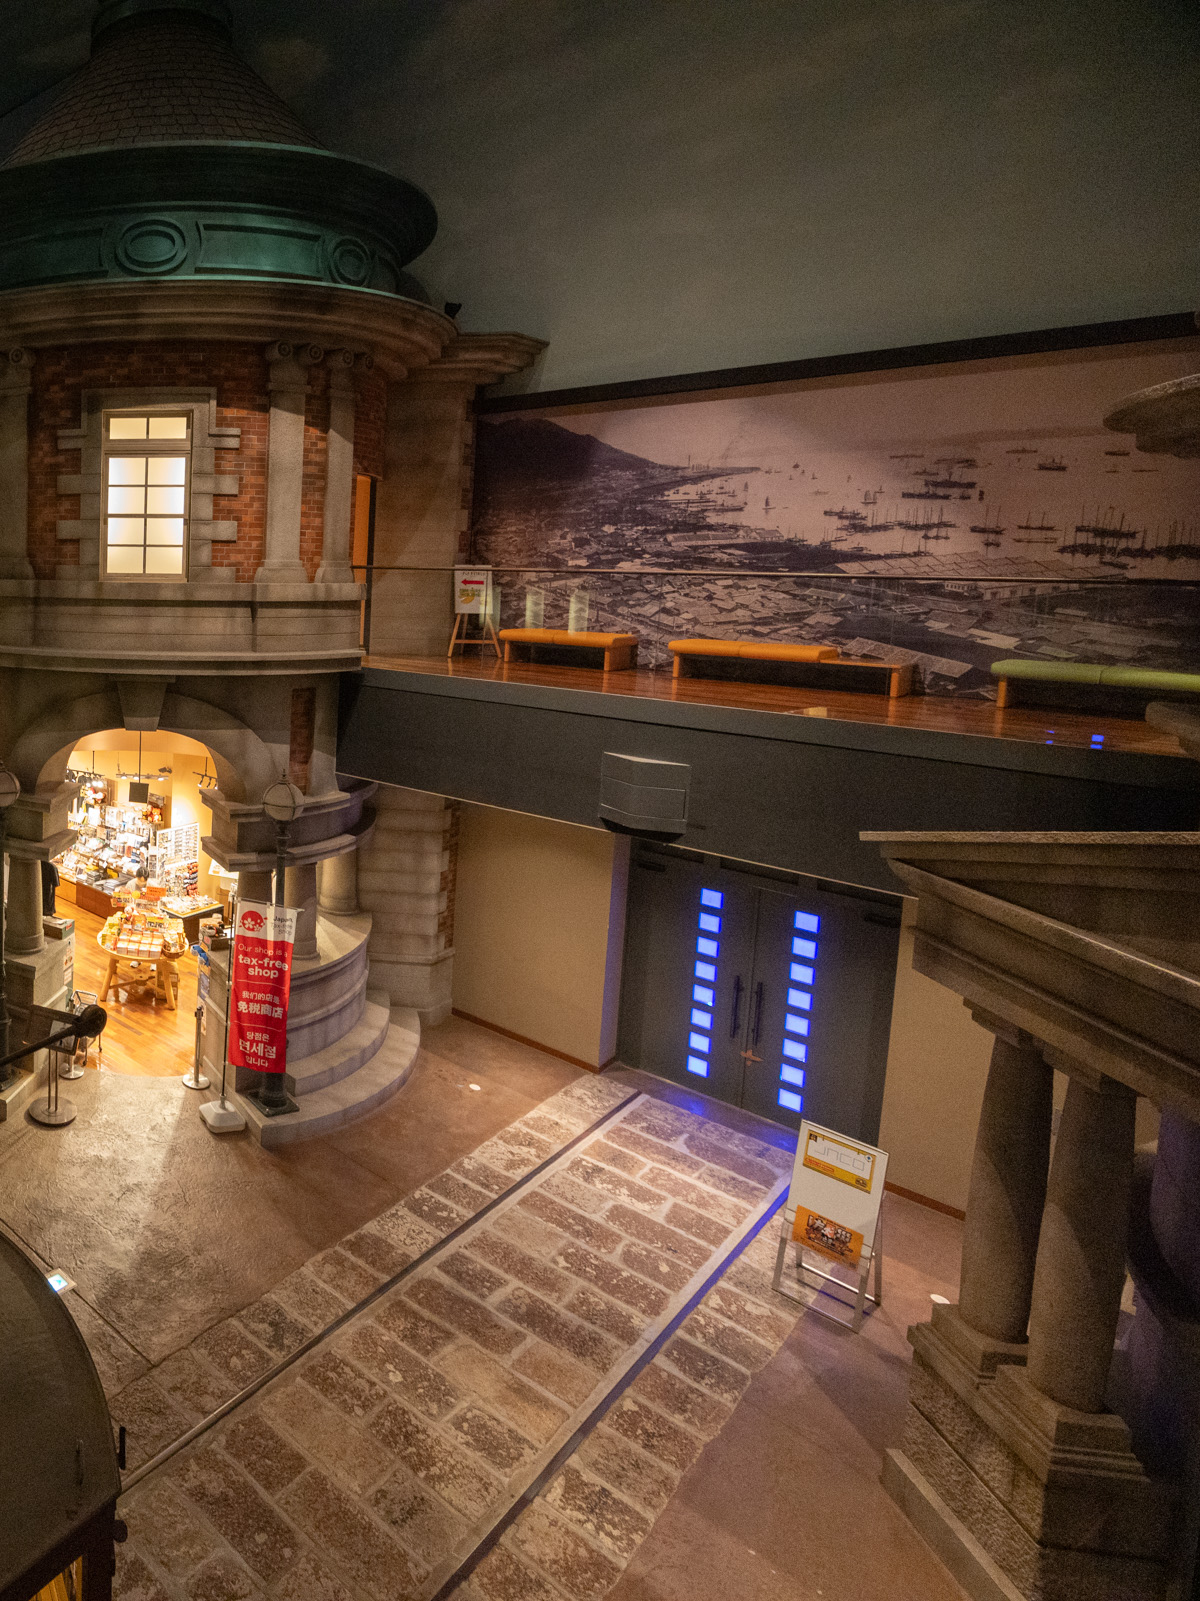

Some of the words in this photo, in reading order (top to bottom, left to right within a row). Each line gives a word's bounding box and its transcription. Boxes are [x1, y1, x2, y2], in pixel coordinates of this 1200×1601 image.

[238, 943, 252, 952] Our
[254, 946, 274, 957] shop
[276, 948, 282, 956] is
[238, 954, 289, 971] tax-free
[248, 966, 279, 979] shop
[237, 1001, 283, 1019] 免税商店
[246, 1031, 270, 1043] 당점은
[239, 1038, 276, 1059] 면세점
[245, 1055, 269, 1068] 입니다
